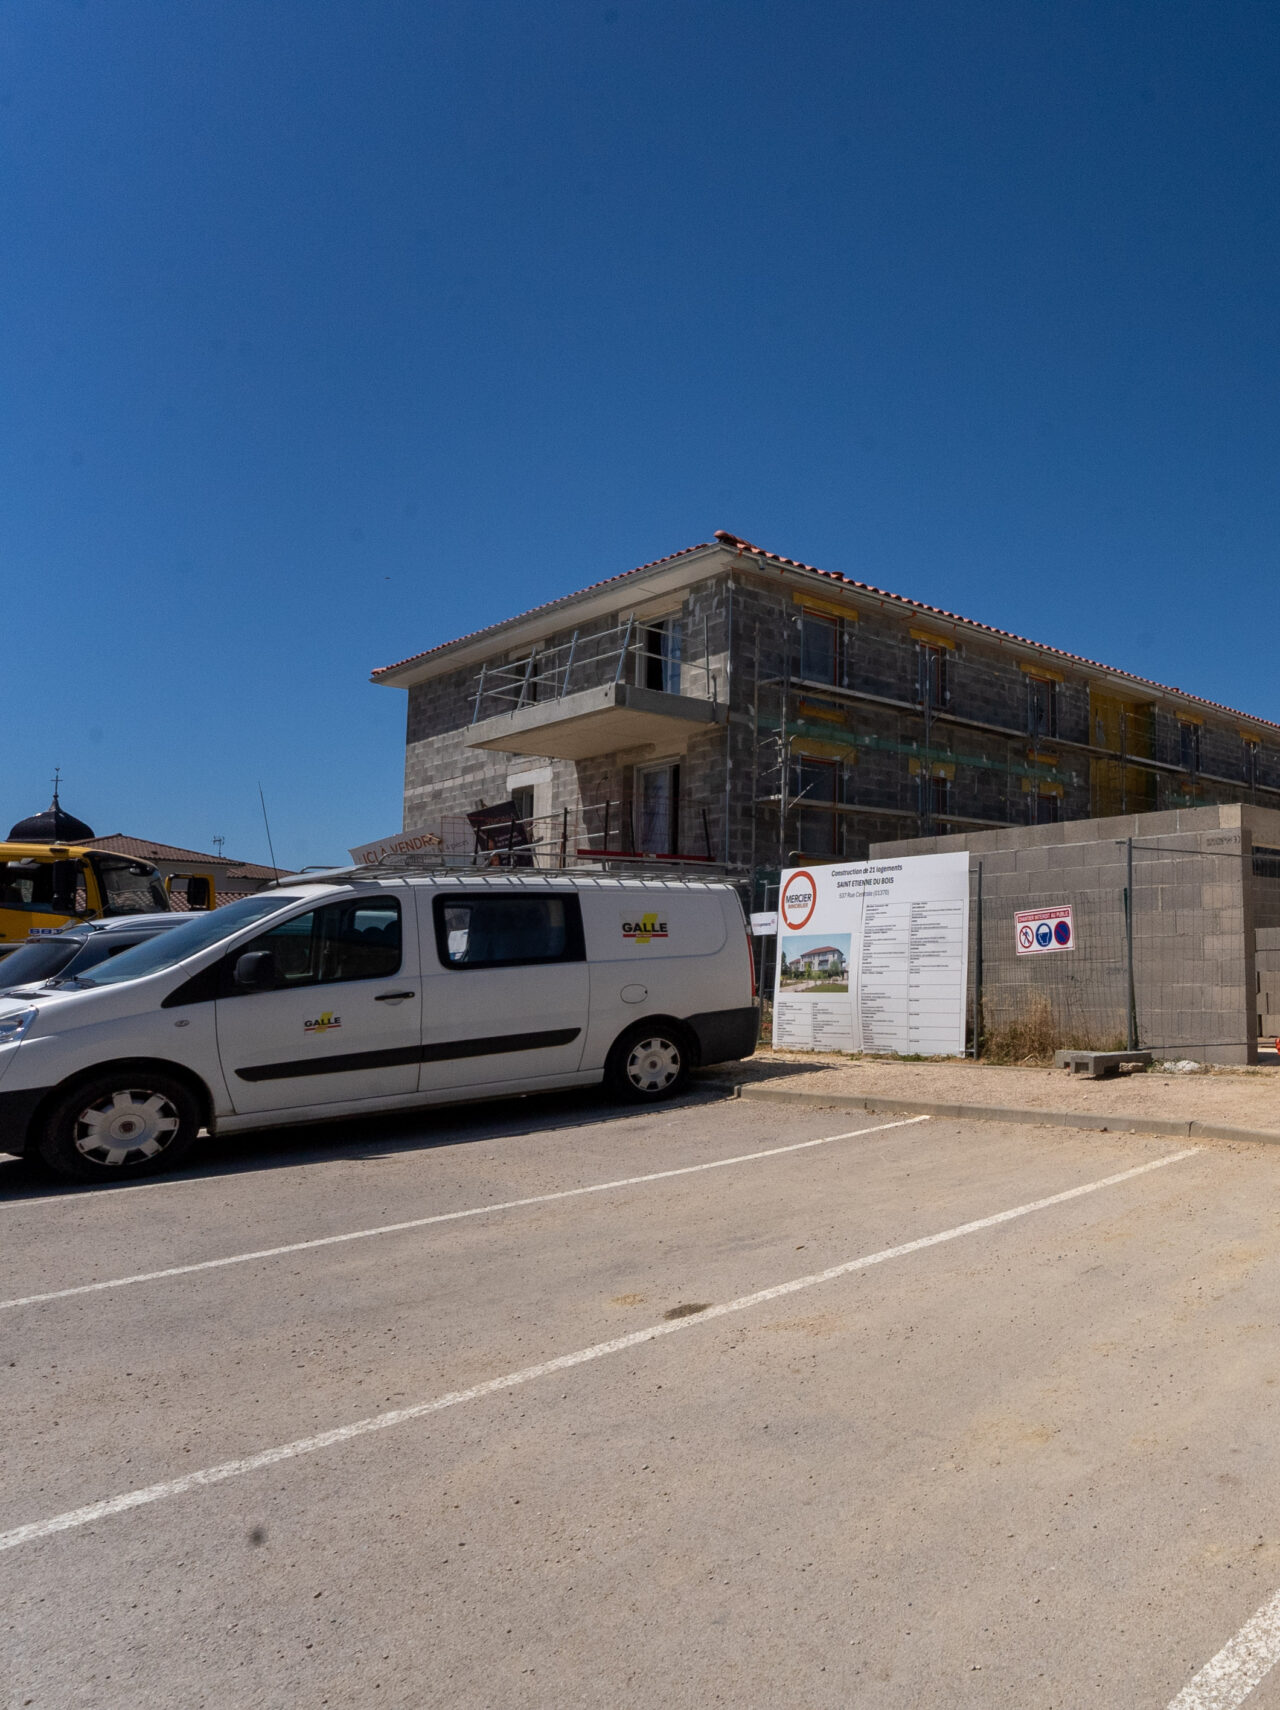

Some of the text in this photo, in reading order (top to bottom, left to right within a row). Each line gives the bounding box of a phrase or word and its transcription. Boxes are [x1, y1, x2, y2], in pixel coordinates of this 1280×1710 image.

[362, 850, 378, 864] ICI
[831, 868, 862, 877] Construction
[876, 864, 903, 874] logements
[837, 880, 851, 888] SAINT
[852, 878, 873, 887] ETIENNE
[881, 877, 894, 885] BOIS
[786, 893, 812, 903] MERCIER
[622, 922, 668, 933] GALLE
[304, 1017, 341, 1027] GALLE
